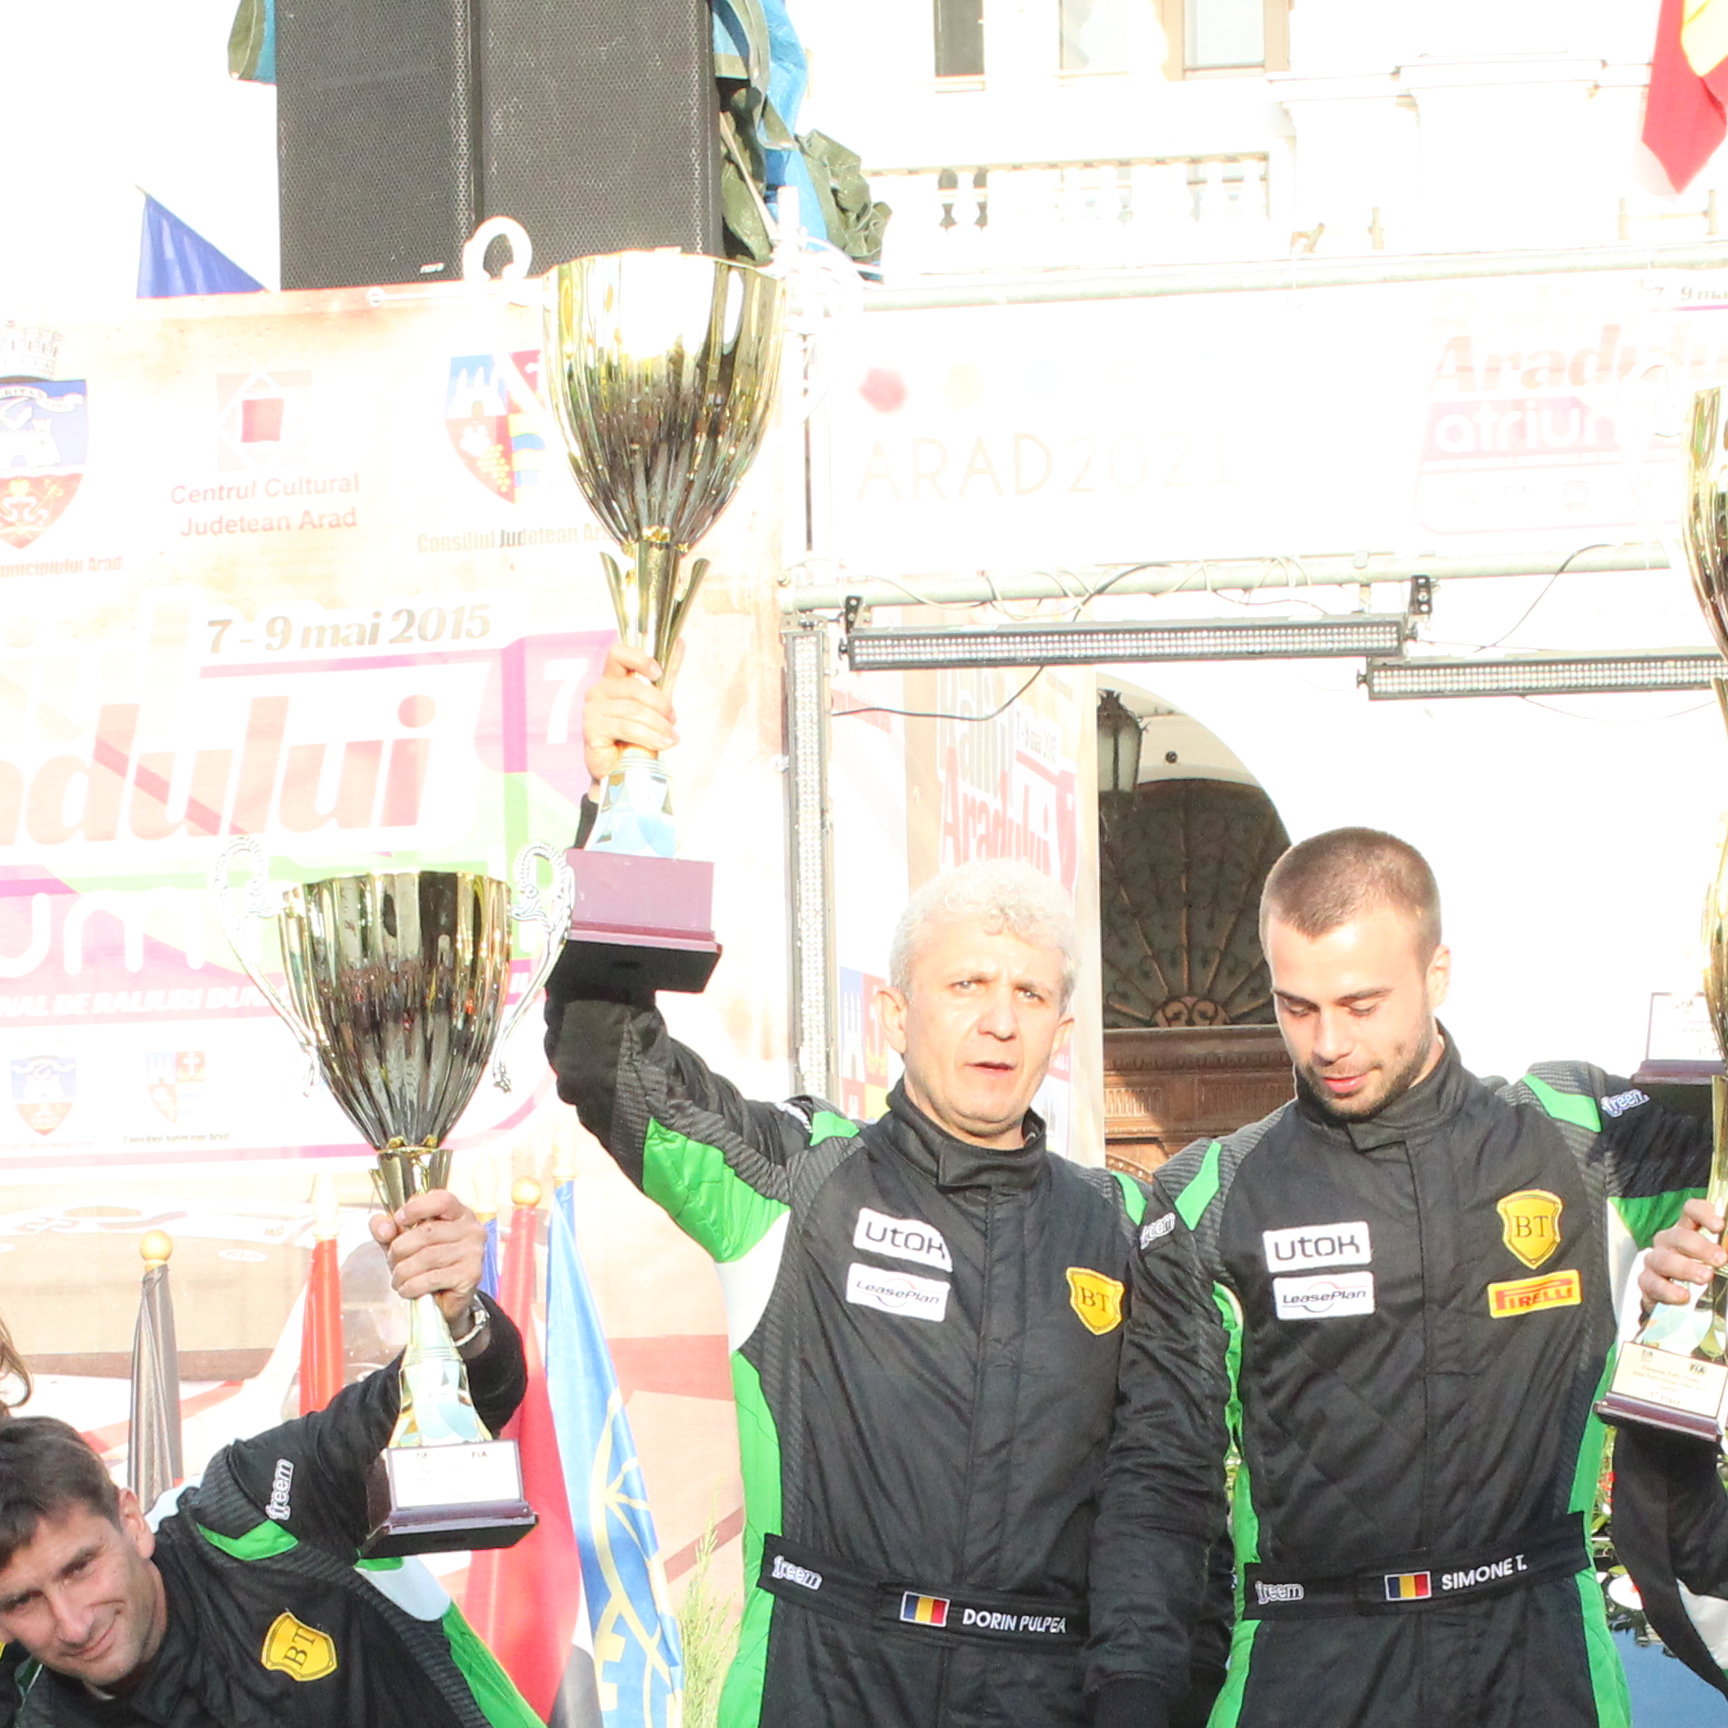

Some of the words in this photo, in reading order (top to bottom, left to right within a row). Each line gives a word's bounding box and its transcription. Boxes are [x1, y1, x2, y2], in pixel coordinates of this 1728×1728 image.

[170, 482, 258, 505] Centrul
[264, 472, 360, 499] Cultural
[179, 510, 289, 537] Judetean
[295, 505, 358, 530] Arad
[416, 528, 494, 554] Consiliul
[498, 523, 579, 548] Judetean
[87, 555, 123, 572] Arad
[208, 620, 233, 654] 7
[264, 616, 293, 652] 9
[300, 612, 381, 649] mai
[390, 603, 490, 642] 2015
[542, 659, 589, 745] 7
[54, 992, 89, 1017] DE
[1515, 1213, 1550, 1239] BT
[855, 1279, 940, 1306] LeasePlan
[1081, 1287, 1112, 1315] BT
[1282, 1289, 1366, 1305] LeasePlan
[1496, 1277, 1573, 1311] PIRELLI
[266, 1458, 294, 1520] freem
[772, 1555, 822, 1590] freem
[962, 1608, 1016, 1631] DORIN
[1019, 1614, 1066, 1634] PULPEA
[1255, 1581, 1304, 1605] freem
[1441, 1557, 1514, 1591] SIMONE
[1515, 1554, 1528, 1572] T.
[284, 1629, 316, 1669] BT
